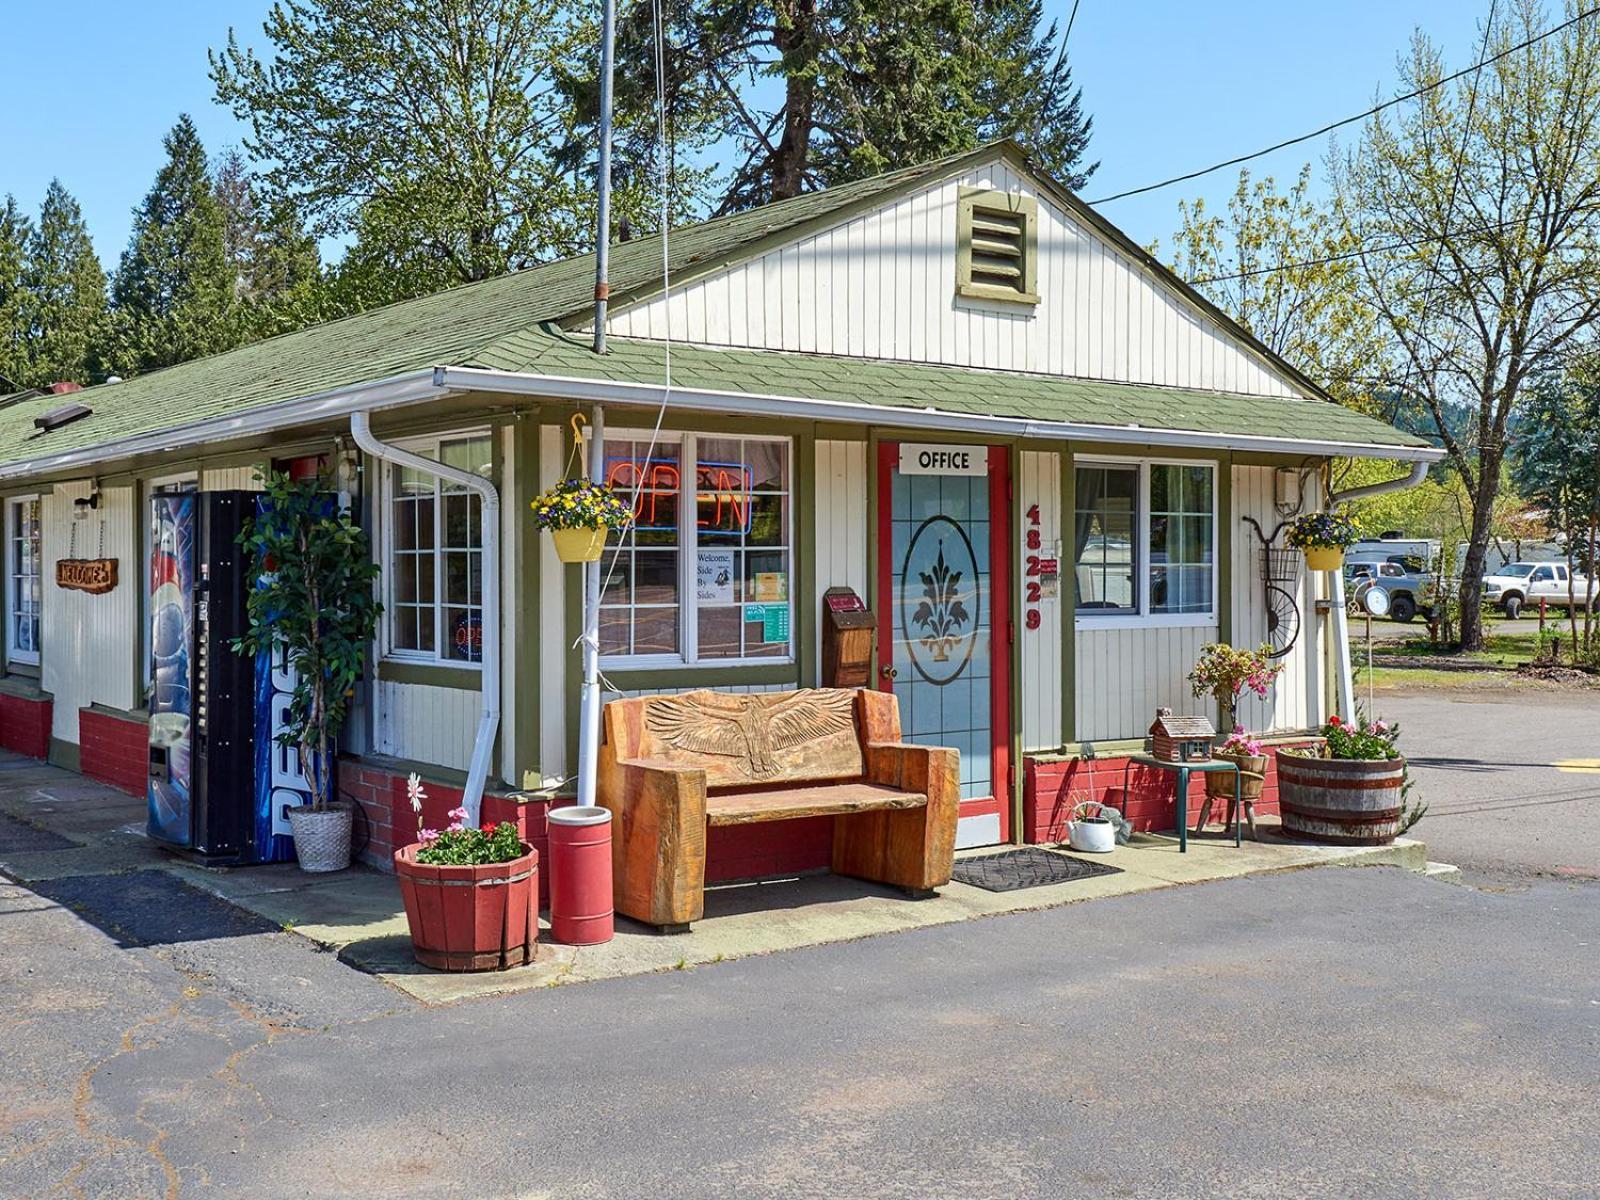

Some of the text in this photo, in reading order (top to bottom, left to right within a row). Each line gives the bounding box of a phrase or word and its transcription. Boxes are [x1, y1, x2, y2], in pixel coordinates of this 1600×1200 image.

[918, 451, 969, 469] OFFICE
[60, 563, 102, 584] WELCOME
[697, 565, 712, 575] Side
[1026, 504, 1041, 630] 48229
[697, 578, 706, 588] By
[455, 627, 482, 647] OPE
